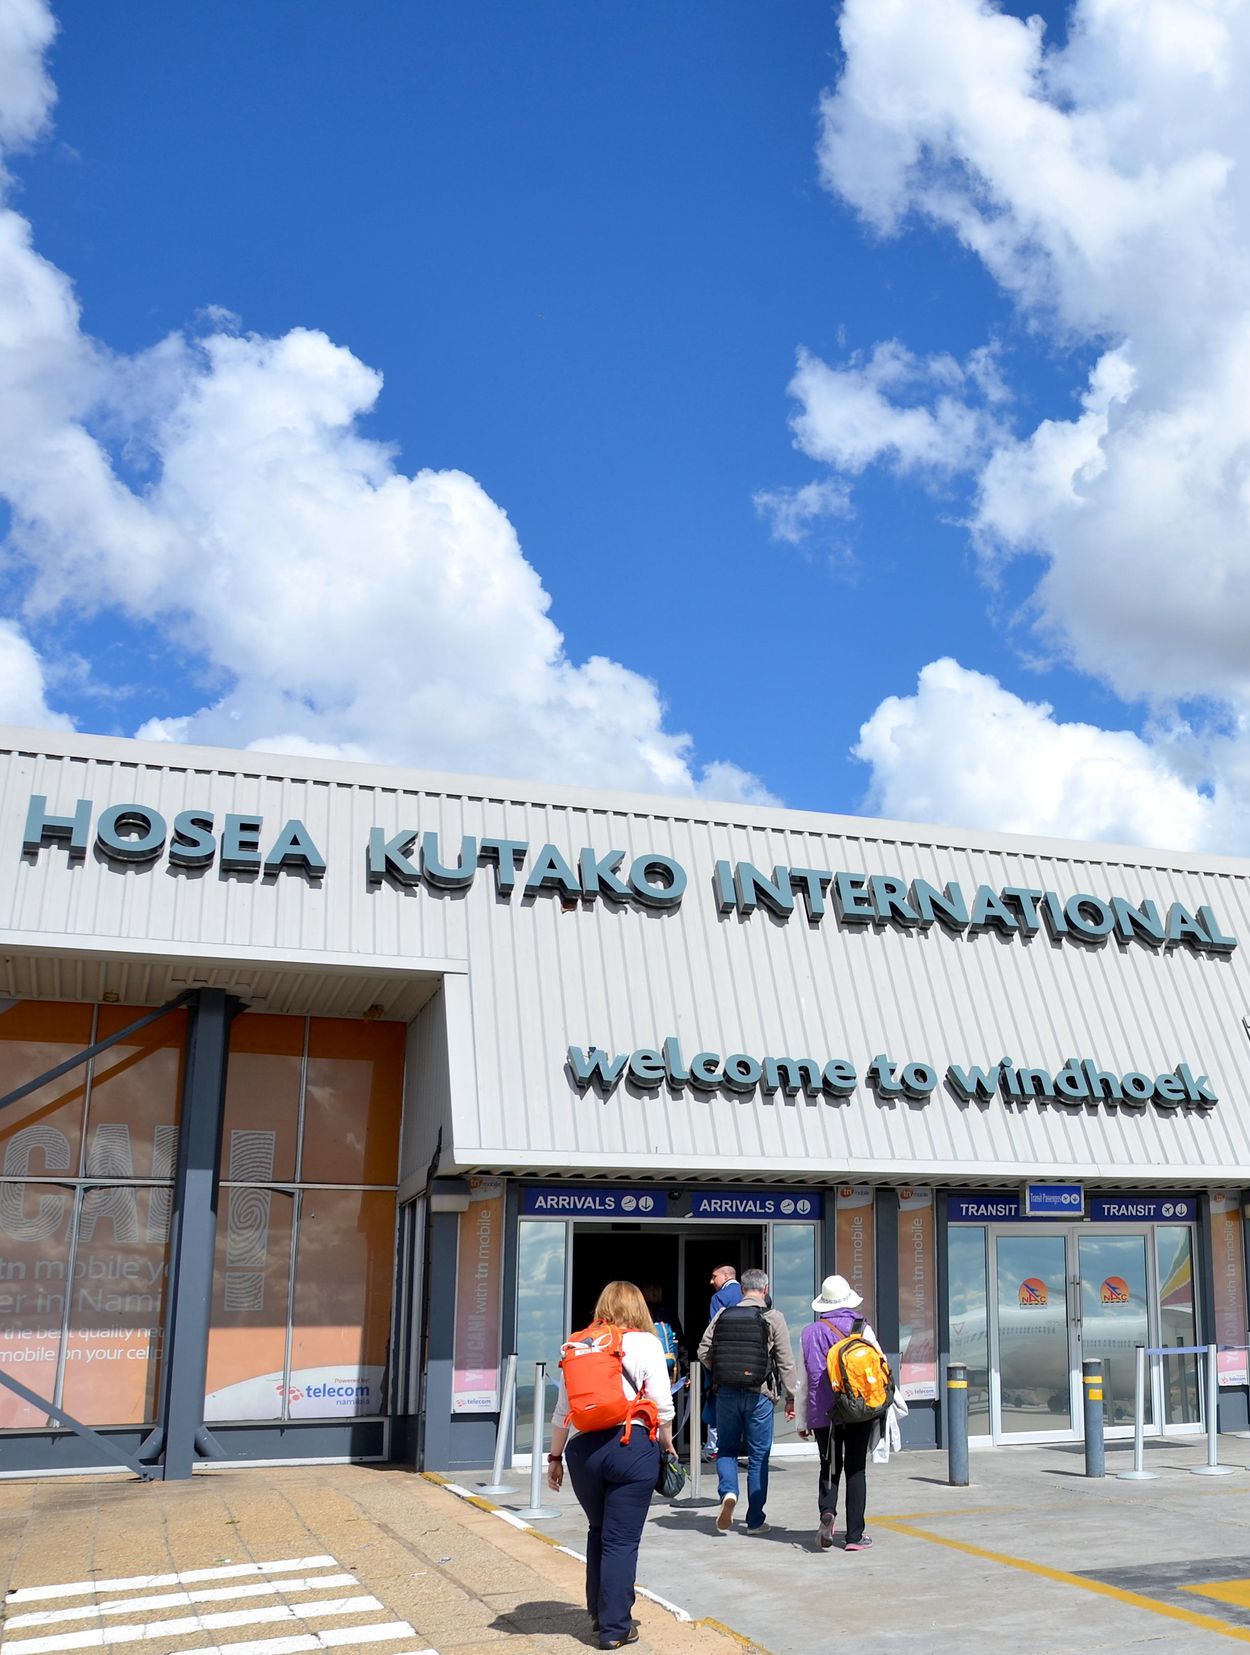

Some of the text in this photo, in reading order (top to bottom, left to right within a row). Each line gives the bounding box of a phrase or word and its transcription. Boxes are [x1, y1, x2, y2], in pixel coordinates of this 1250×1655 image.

[23, 795, 326, 877] HOSEA
[369, 827, 688, 907] KUTAKO
[714, 860, 1237, 953] INTERNATIONAL
[568, 1036, 1219, 1108] welcome to windhoek
[534, 1196, 615, 1210] ARRIVALS
[699, 1199, 775, 1213] ARRIVALS
[960, 1204, 1018, 1216] TRANSIT
[1102, 1204, 1157, 1216] TRANSIT
[476, 1209, 491, 1259] mobile
[851, 1215, 863, 1263] mobile
[911, 1217, 924, 1263] mobile
[1223, 1219, 1236, 1261] mobile
[474, 1262, 488, 1280] tn
[912, 1265, 924, 1281] tn
[473, 1282, 488, 1314] with
[4, 1324, 33, 1340] the
[78, 1323, 134, 1341] quality
[85, 1348, 124, 1364] your
[305, 1383, 370, 1398] telecom
